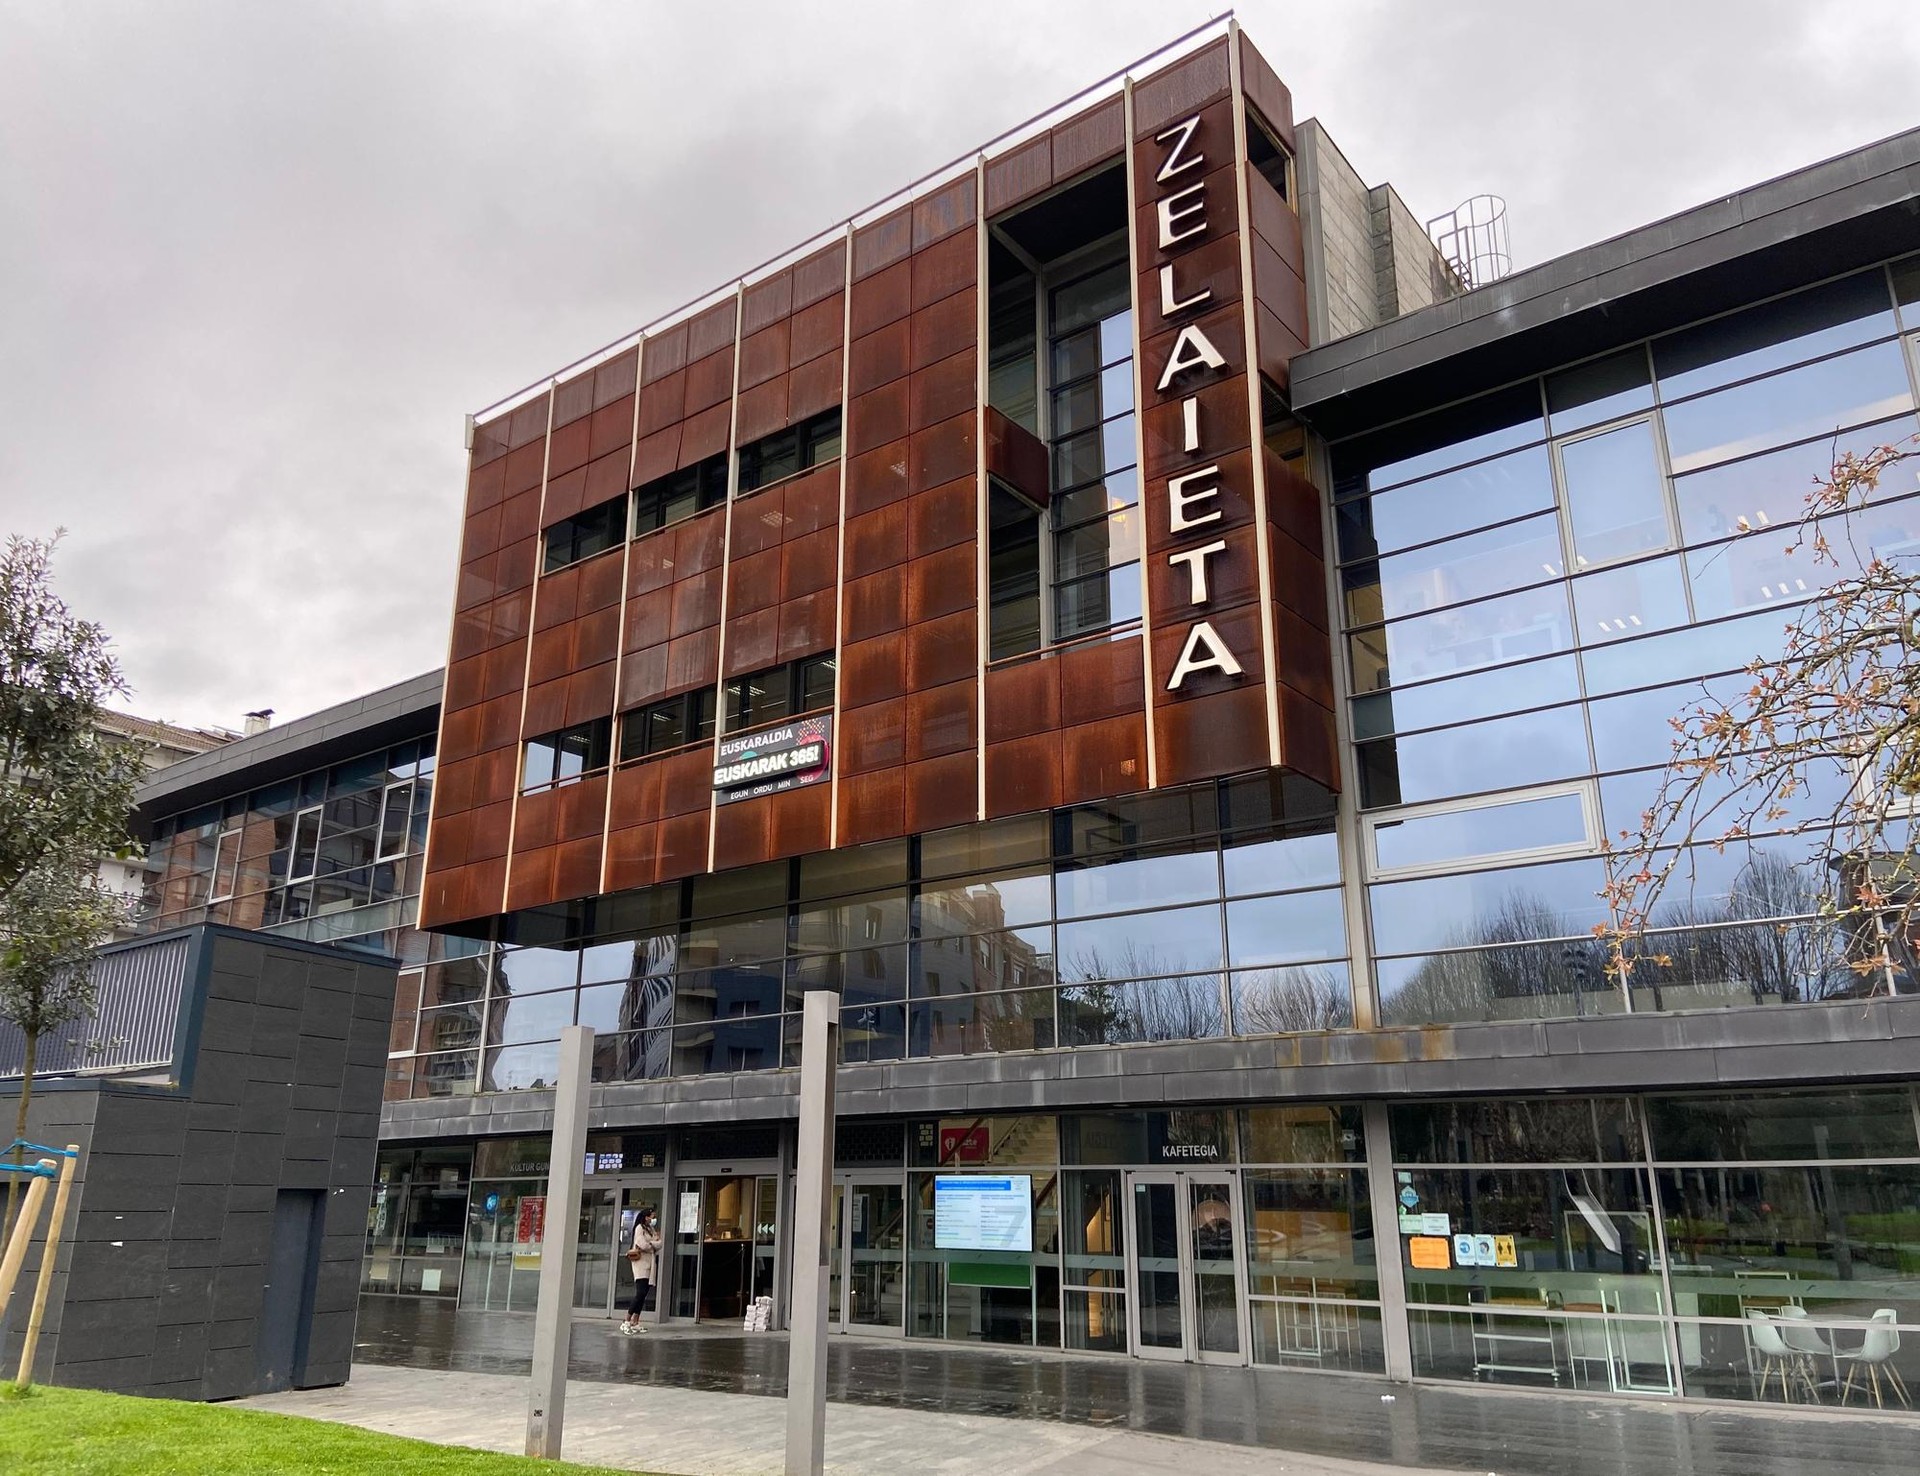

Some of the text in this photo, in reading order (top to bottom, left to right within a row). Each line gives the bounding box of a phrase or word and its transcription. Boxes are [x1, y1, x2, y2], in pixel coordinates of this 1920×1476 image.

[1154, 113, 1246, 692] ZELAIETA
[720, 728, 794, 756] EUSKARALDIA
[713, 745, 819, 785] EUSKARAK 365!
[730, 774, 814, 800] EGUN ORDU MIN SEG
[1162, 1144, 1218, 1157] KAFETEGIA
